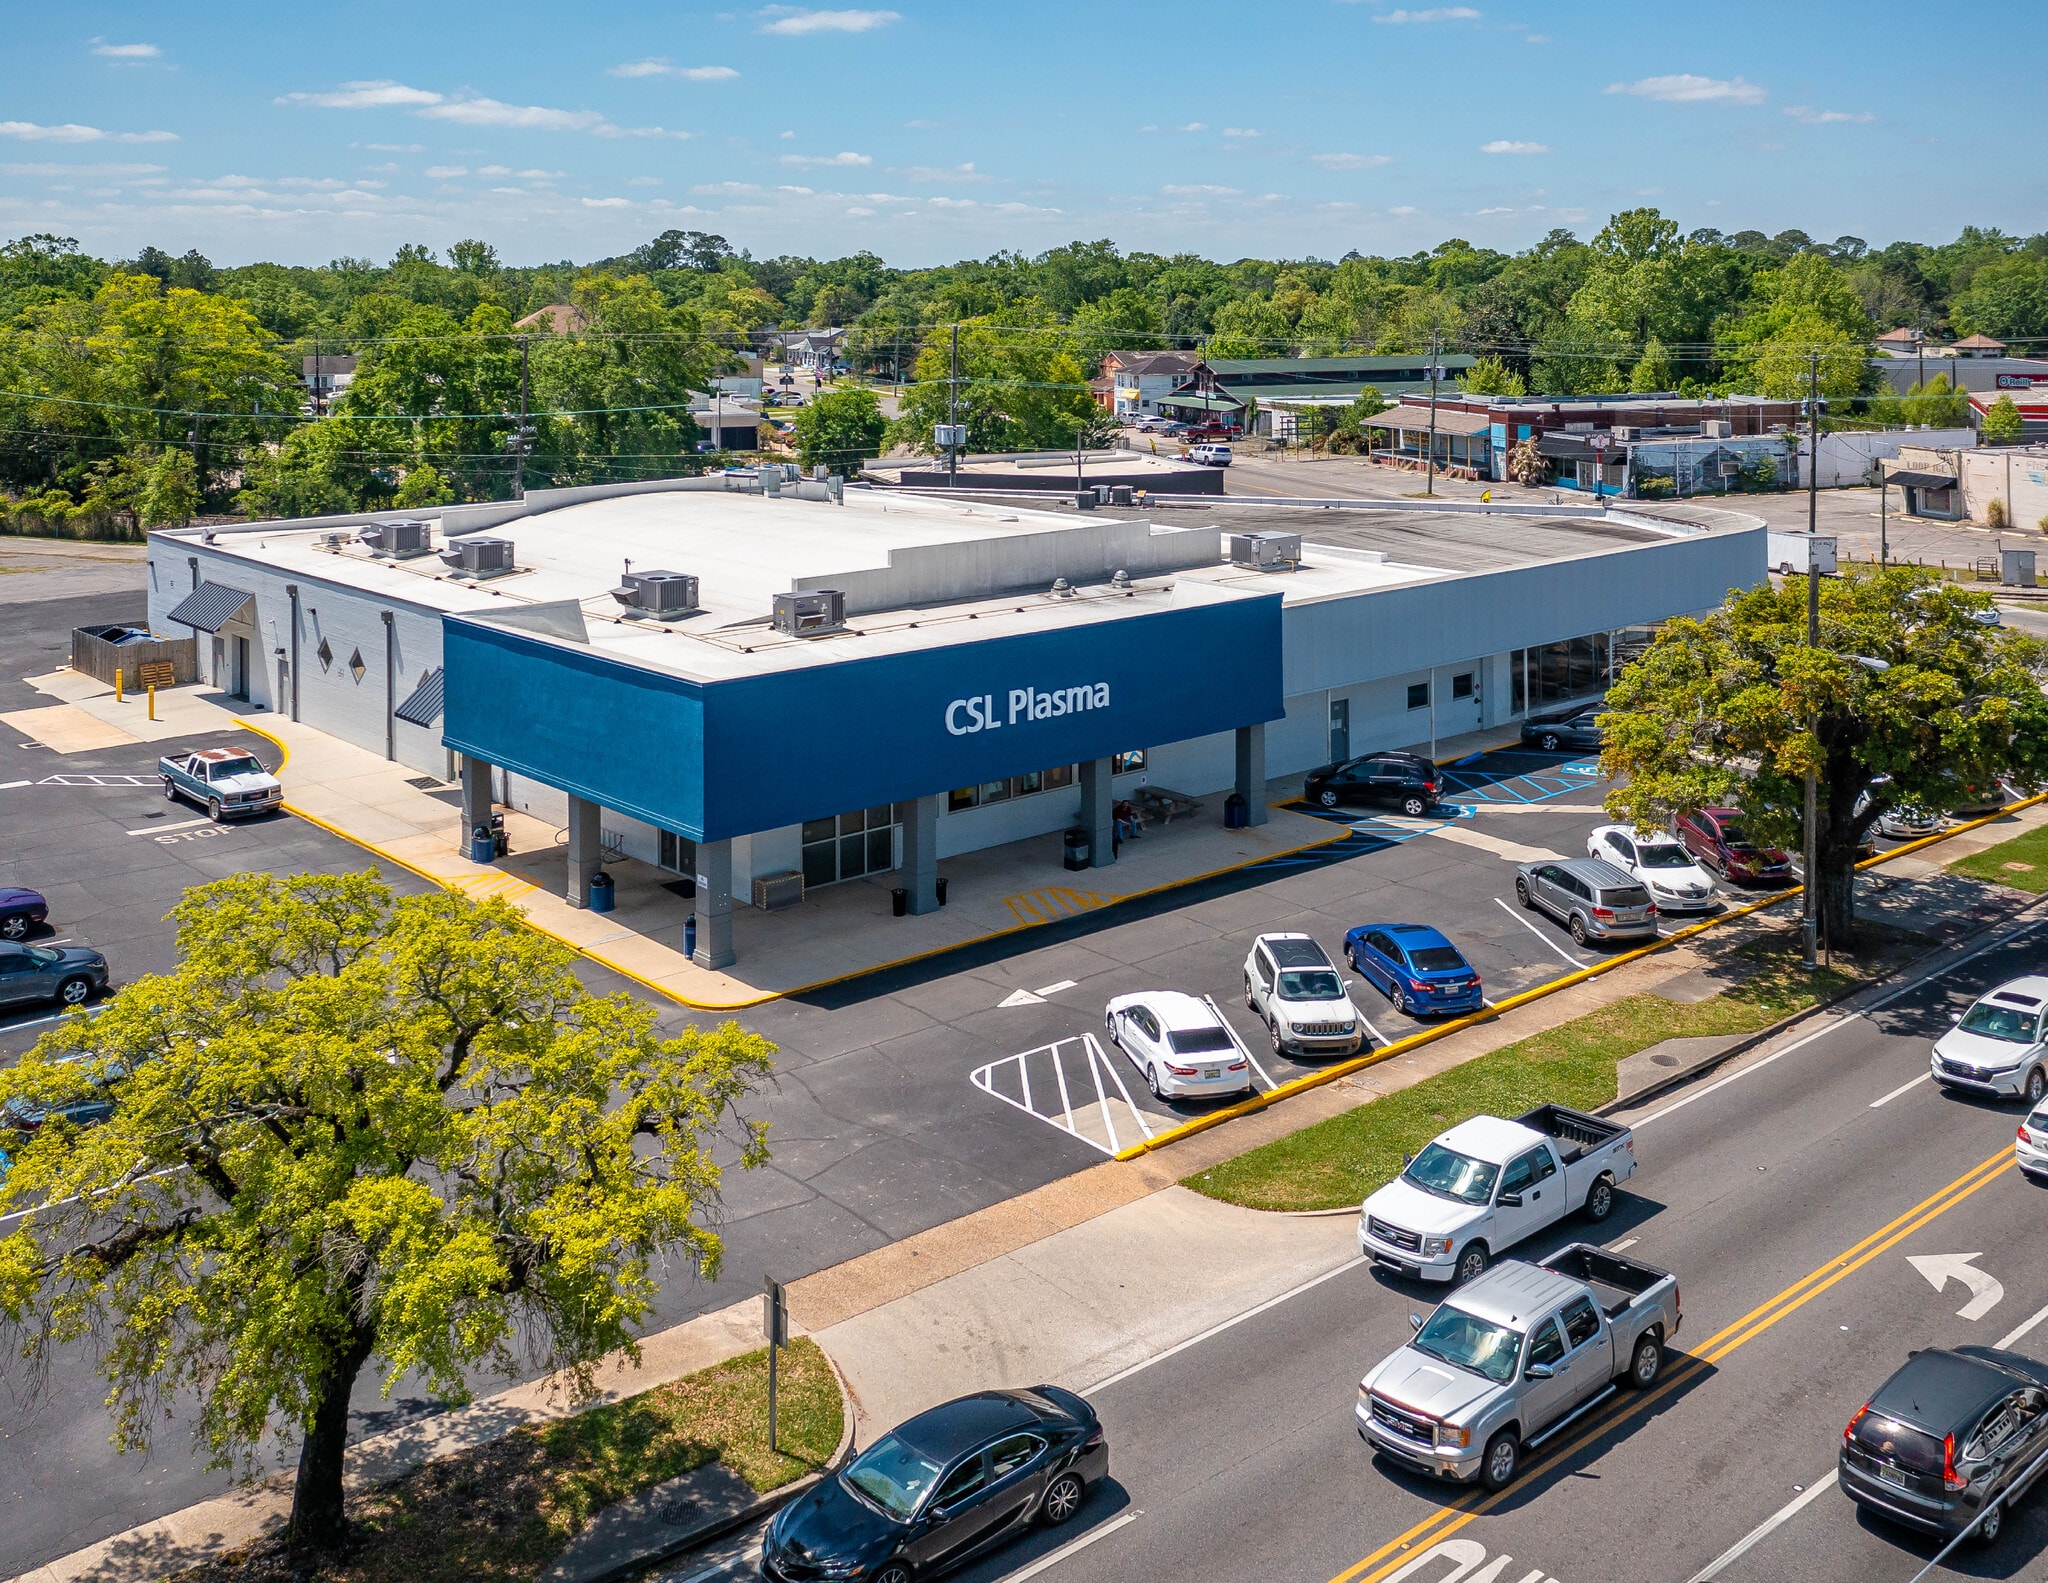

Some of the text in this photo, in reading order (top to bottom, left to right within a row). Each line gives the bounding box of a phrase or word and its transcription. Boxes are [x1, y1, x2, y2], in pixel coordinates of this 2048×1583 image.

[944, 682, 1110, 736] CSL Plasma
[154, 824, 237, 845] STOP
